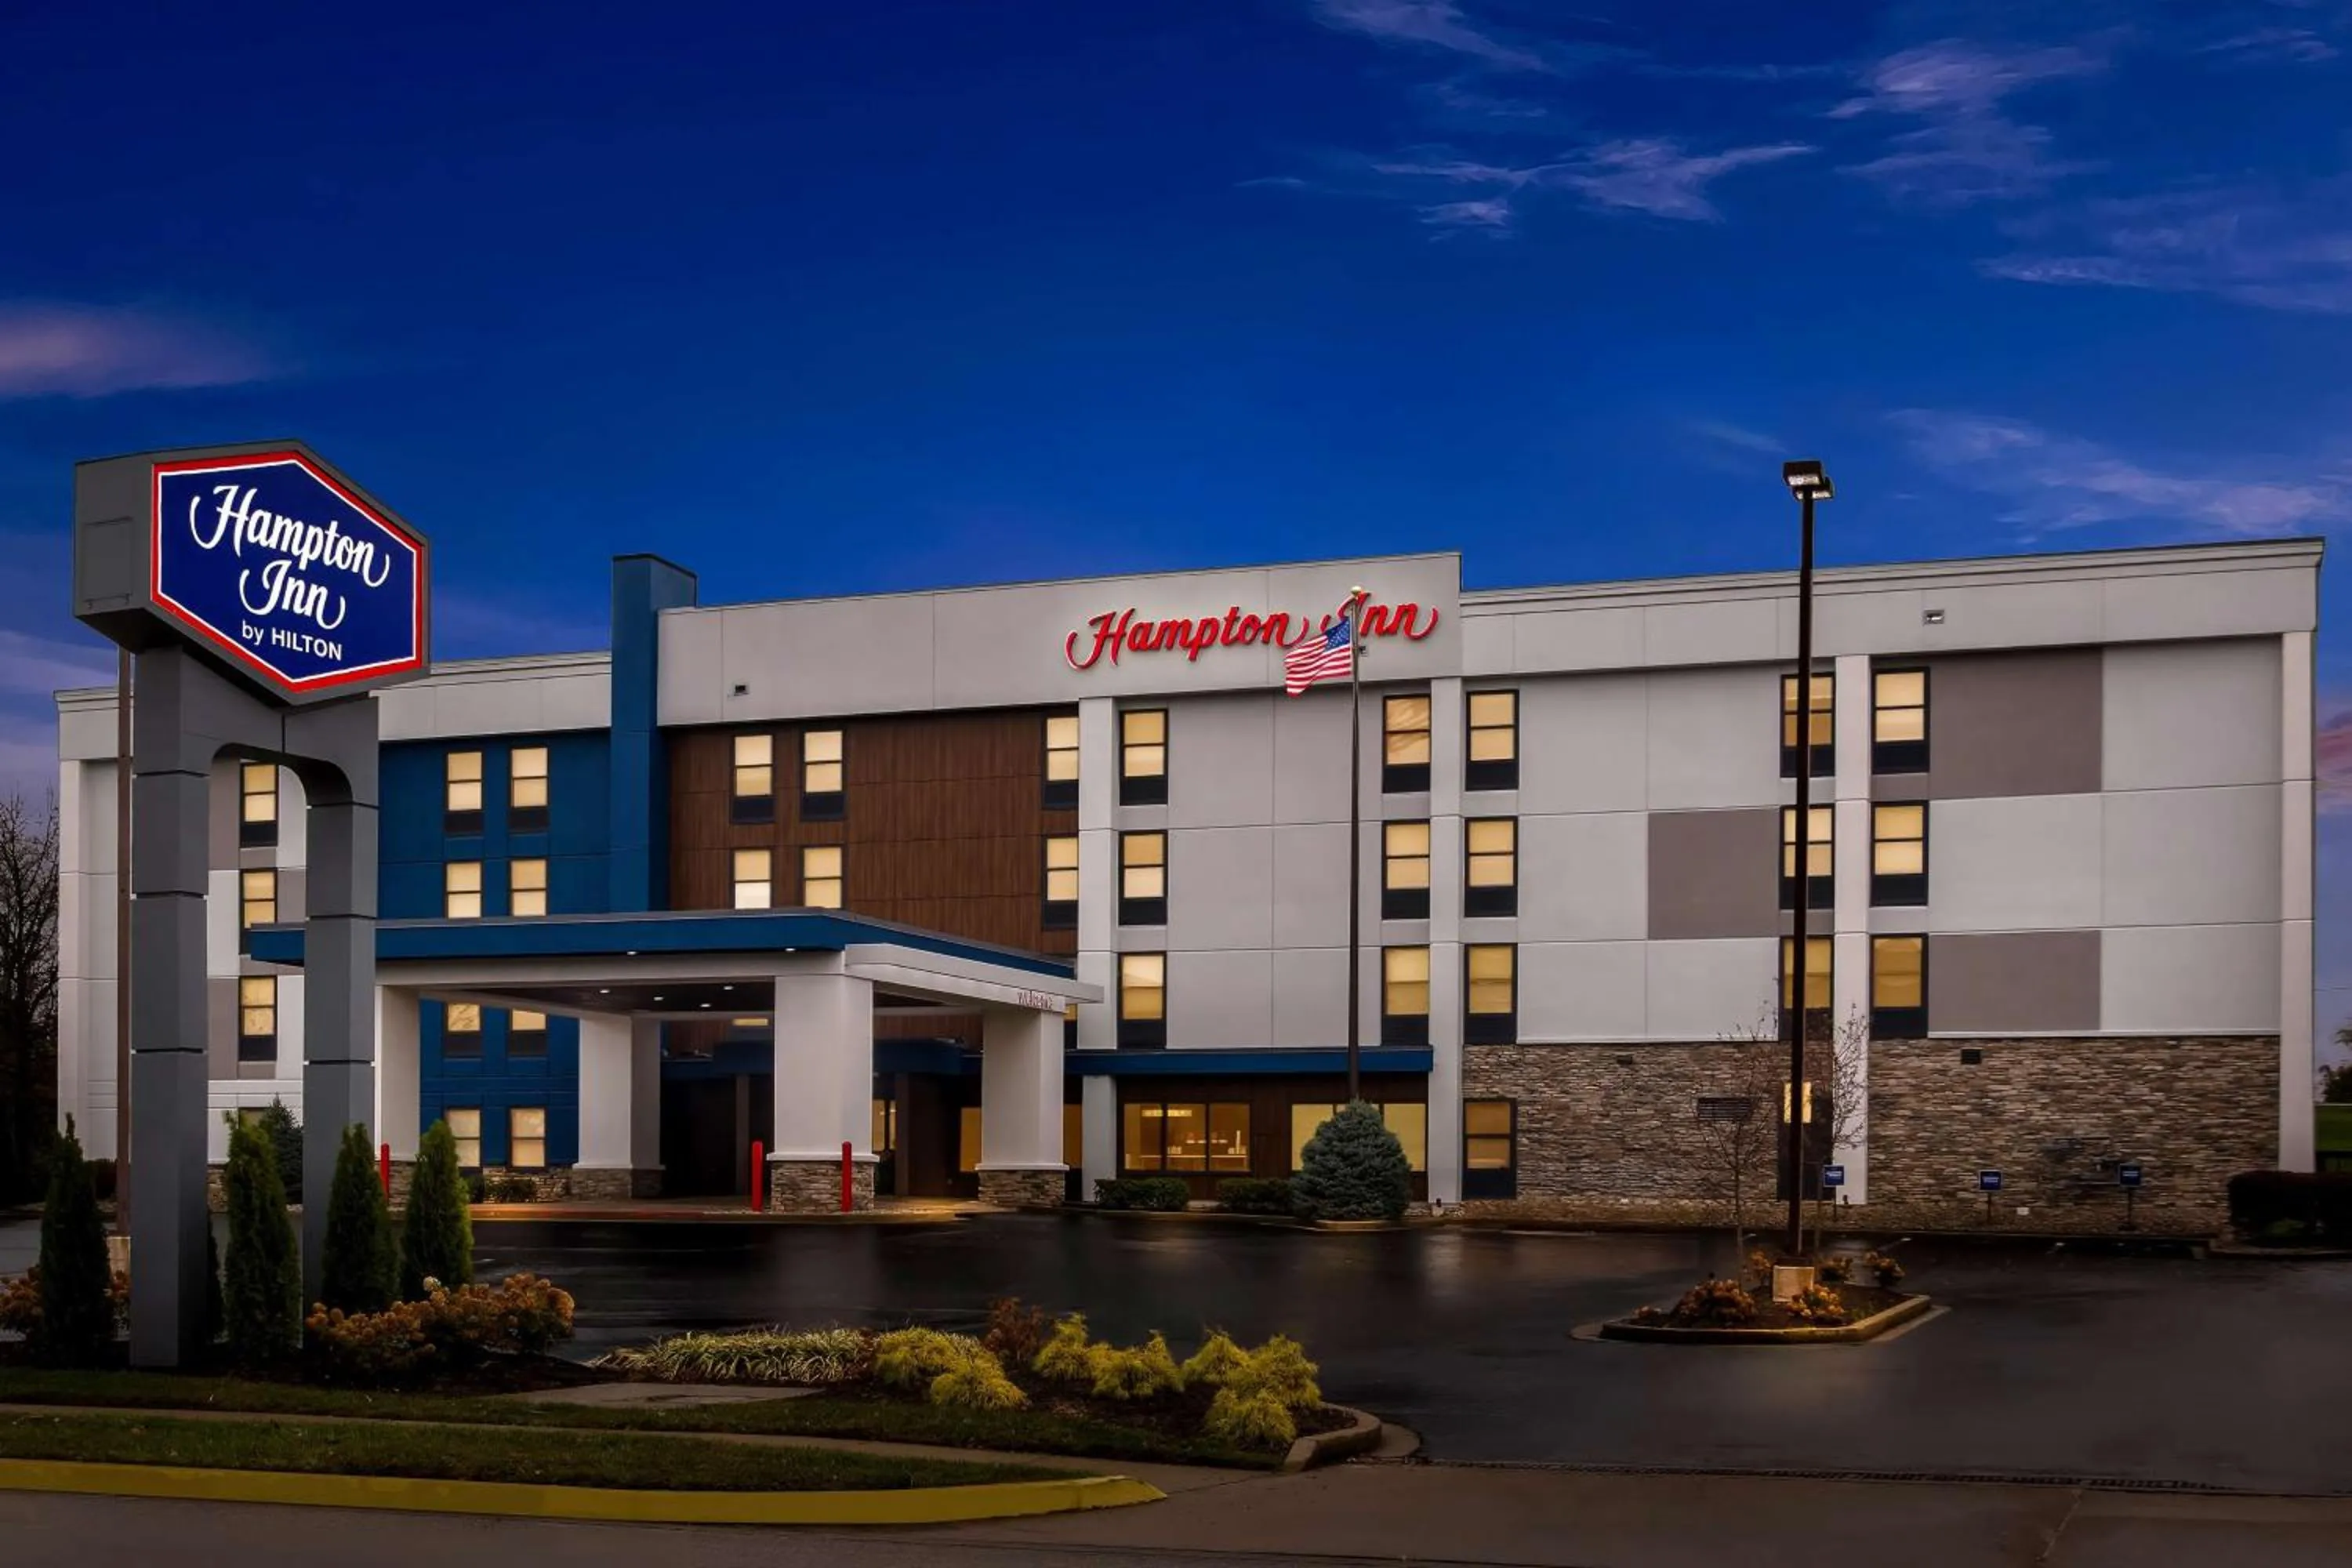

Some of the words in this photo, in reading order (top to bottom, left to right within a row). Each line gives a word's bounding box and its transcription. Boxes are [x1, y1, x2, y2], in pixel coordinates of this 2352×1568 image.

[190, 485, 390, 586] Hampton
[239, 560, 345, 629] Inn
[242, 620, 264, 646] by
[271, 627, 342, 661] HILTON
[1065, 606, 1310, 670] Hampton
